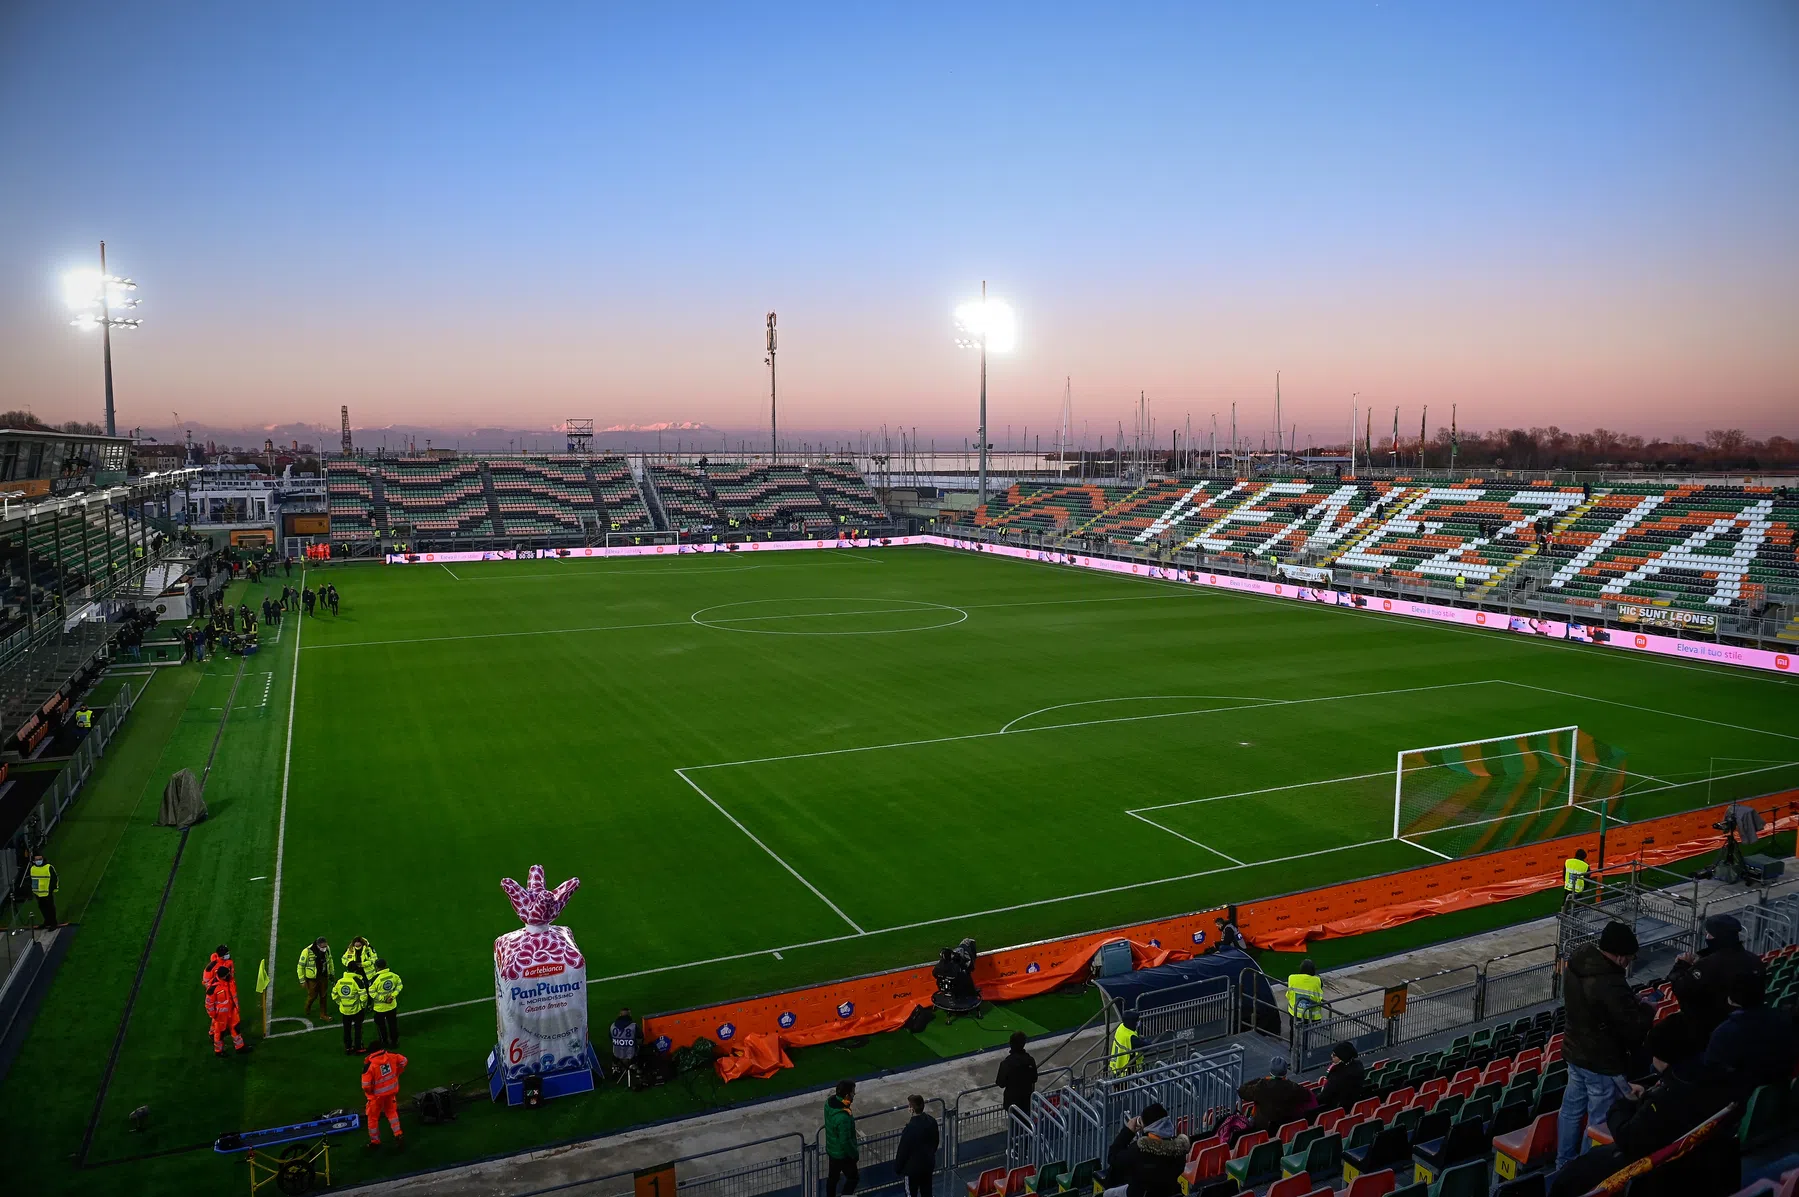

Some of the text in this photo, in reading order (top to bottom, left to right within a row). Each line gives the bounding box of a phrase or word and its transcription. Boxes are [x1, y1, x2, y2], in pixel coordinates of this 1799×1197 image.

[1411, 605, 1427, 614] Eleva
[1619, 605, 1715, 625] HIC SUNT LEONES
[1676, 643, 1743, 661] Eleva il tuo stile
[529, 965, 563, 976] artebianca
[511, 981, 581, 1001] PanPiuma
[526, 992, 574, 1005] MORBIDISSIMO
[1391, 994, 1401, 1014] 2
[551, 1026, 579, 1040] CROSTA
[509, 1037, 523, 1065] 6
[1501, 1160, 1510, 1174] N
[1418, 1171, 1428, 1183] M
[648, 1176, 660, 1197] 1
